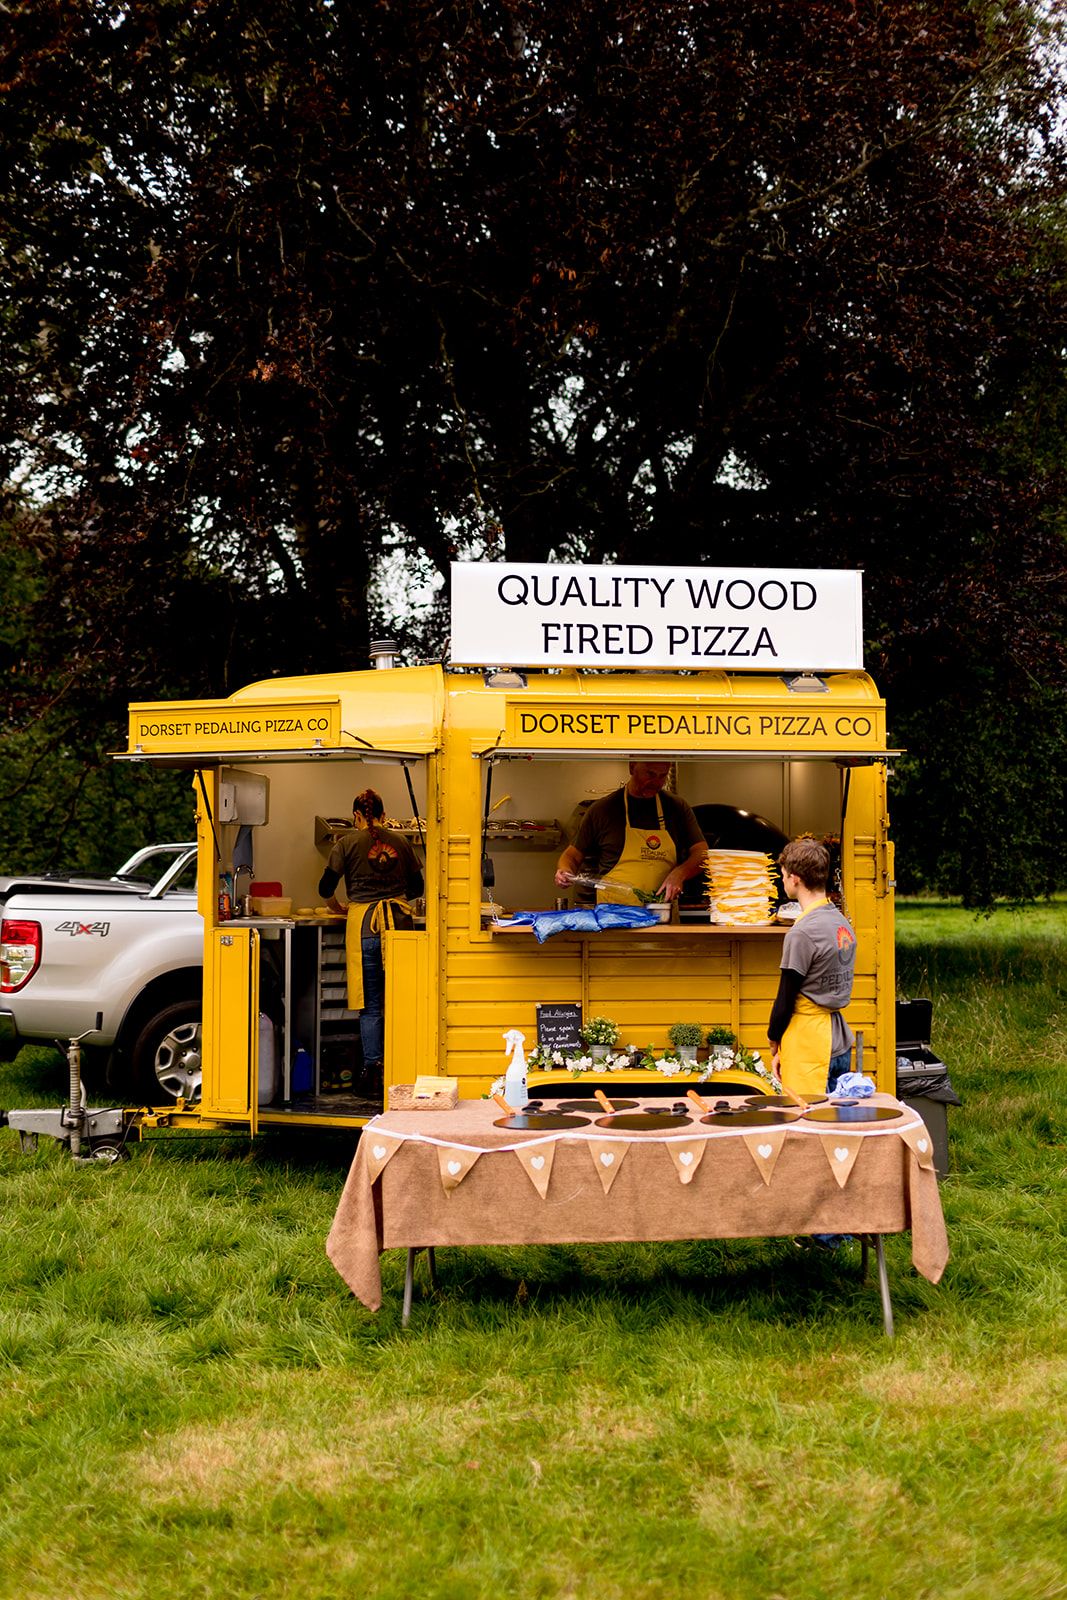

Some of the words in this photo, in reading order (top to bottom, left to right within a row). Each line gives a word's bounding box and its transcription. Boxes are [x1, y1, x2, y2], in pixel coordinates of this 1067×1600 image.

[497, 574, 675, 608] QUALITY
[686, 579, 817, 611] WOOD
[541, 622, 653, 655] FIRED
[667, 625, 778, 657] PIZZA
[140, 722, 191, 737] DORSET
[195, 720, 261, 735] PEDALING
[265, 719, 303, 733] PIZZA
[307, 717, 329, 731] CO
[520, 713, 620, 734] DORSET
[627, 715, 751, 736] PEDALING
[759, 716, 828, 736] PIZZA
[835, 716, 871, 737] CO
[54, 921, 111, 937] 4x4
[540, 1023, 557, 1032] Please
[559, 1024, 575, 1033] speak
[541, 1033, 547, 1042] to
